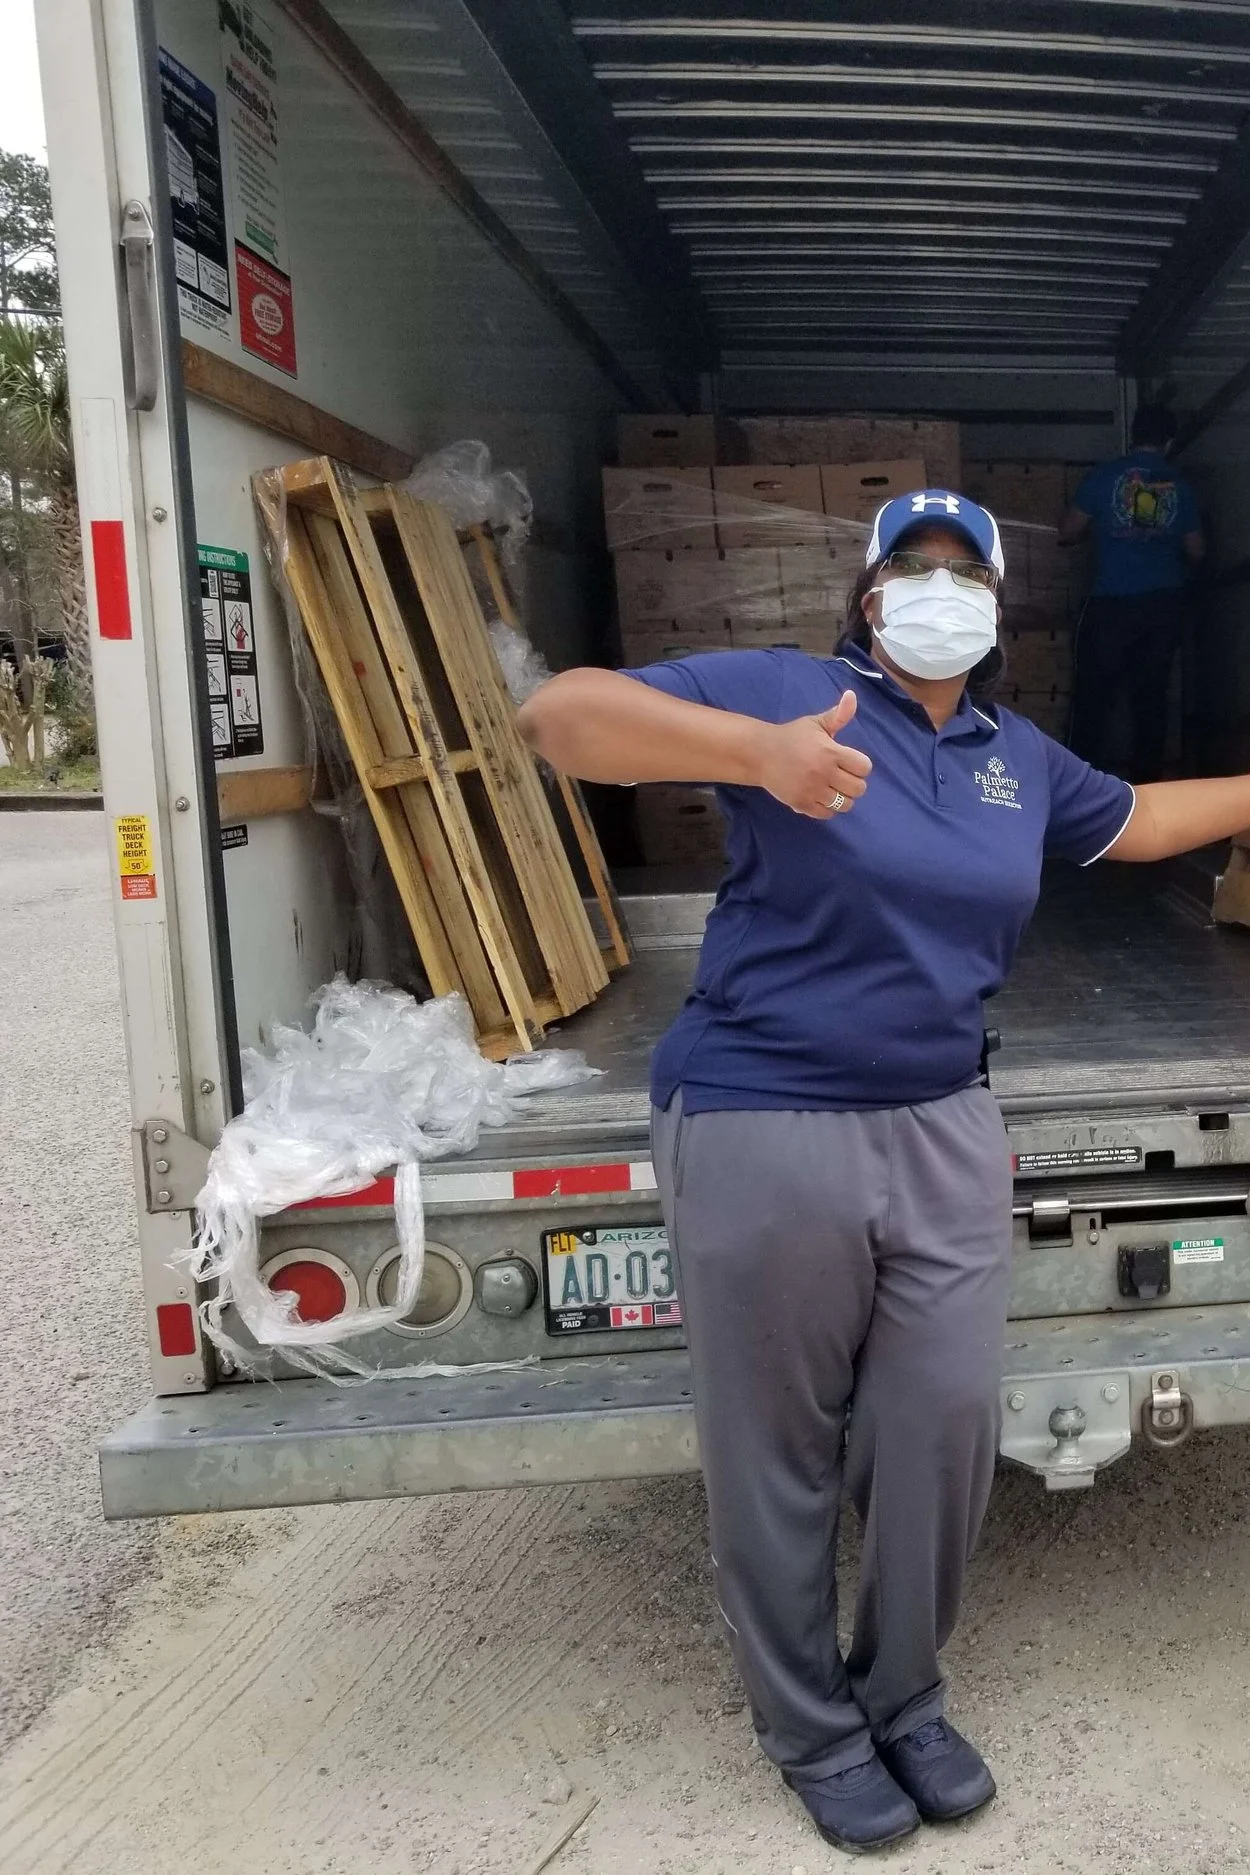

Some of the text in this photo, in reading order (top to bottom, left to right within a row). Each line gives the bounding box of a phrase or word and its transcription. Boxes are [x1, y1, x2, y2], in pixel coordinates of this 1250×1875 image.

[974, 772, 1019, 789] Palmetto
[983, 785, 1015, 800] Palace
[1181, 1239, 1215, 1248] ATTENTION
[562, 1320, 581, 1328] PAID
